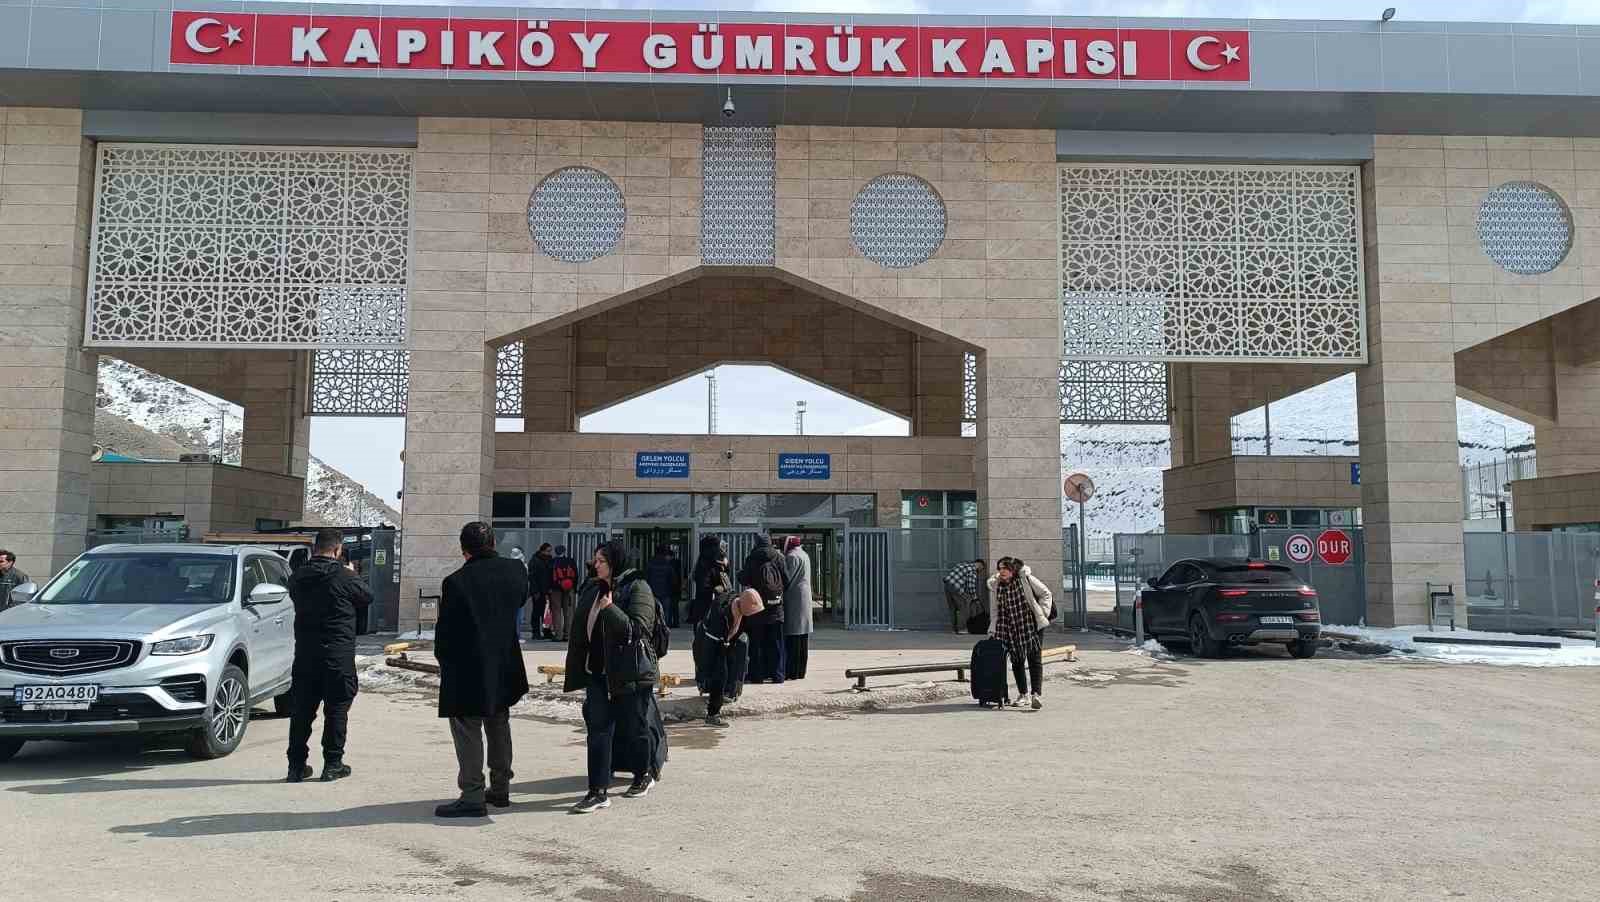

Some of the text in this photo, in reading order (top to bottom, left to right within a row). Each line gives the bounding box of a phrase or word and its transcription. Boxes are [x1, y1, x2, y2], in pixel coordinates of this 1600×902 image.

[291, 20, 1137, 77] KAPIKÖY GÜMRÜK KAPISI
[1292, 543, 1308, 554] 30
[1319, 540, 1349, 554] DUR
